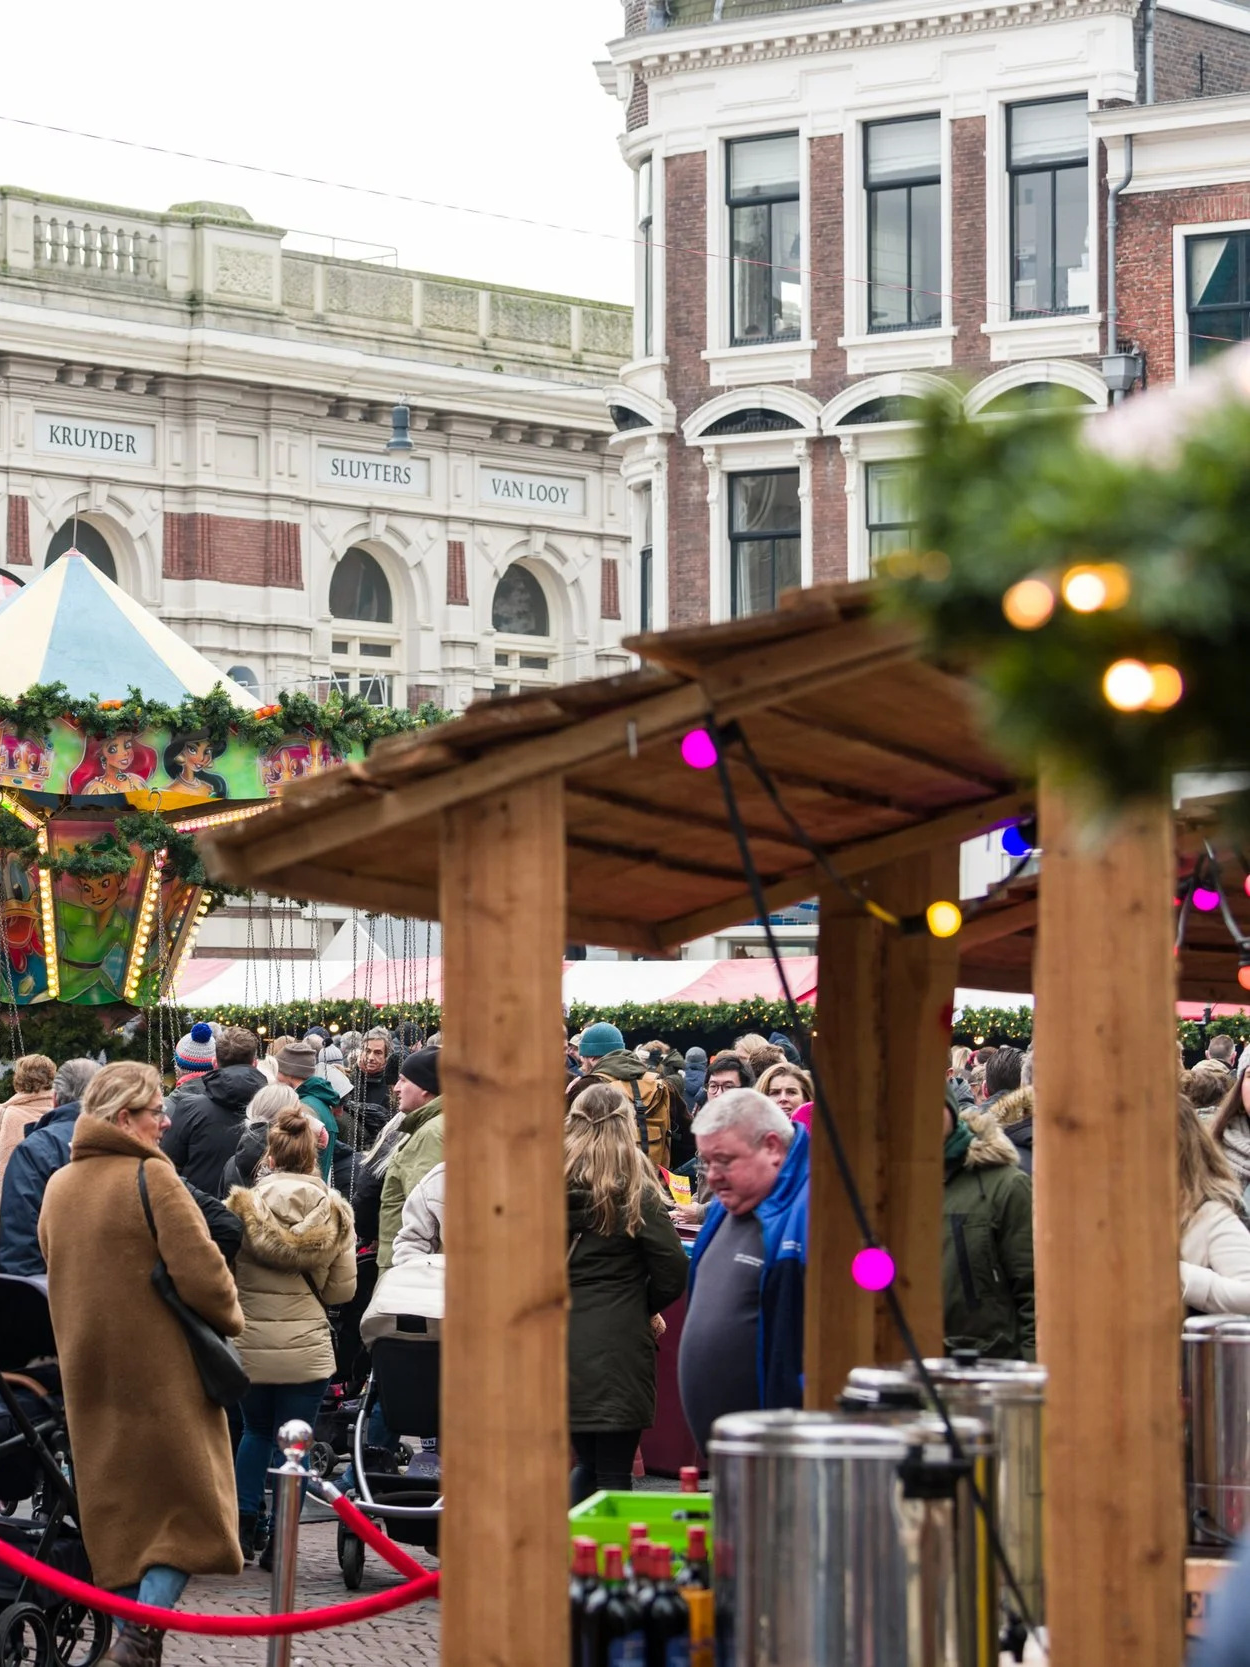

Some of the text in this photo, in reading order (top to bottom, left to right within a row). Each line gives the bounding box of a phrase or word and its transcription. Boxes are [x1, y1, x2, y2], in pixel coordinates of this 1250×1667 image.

[48, 424, 138, 454] KRUYDER
[330, 457, 412, 485] SLUYTERS
[491, 477, 570, 505] VAN LOOY
